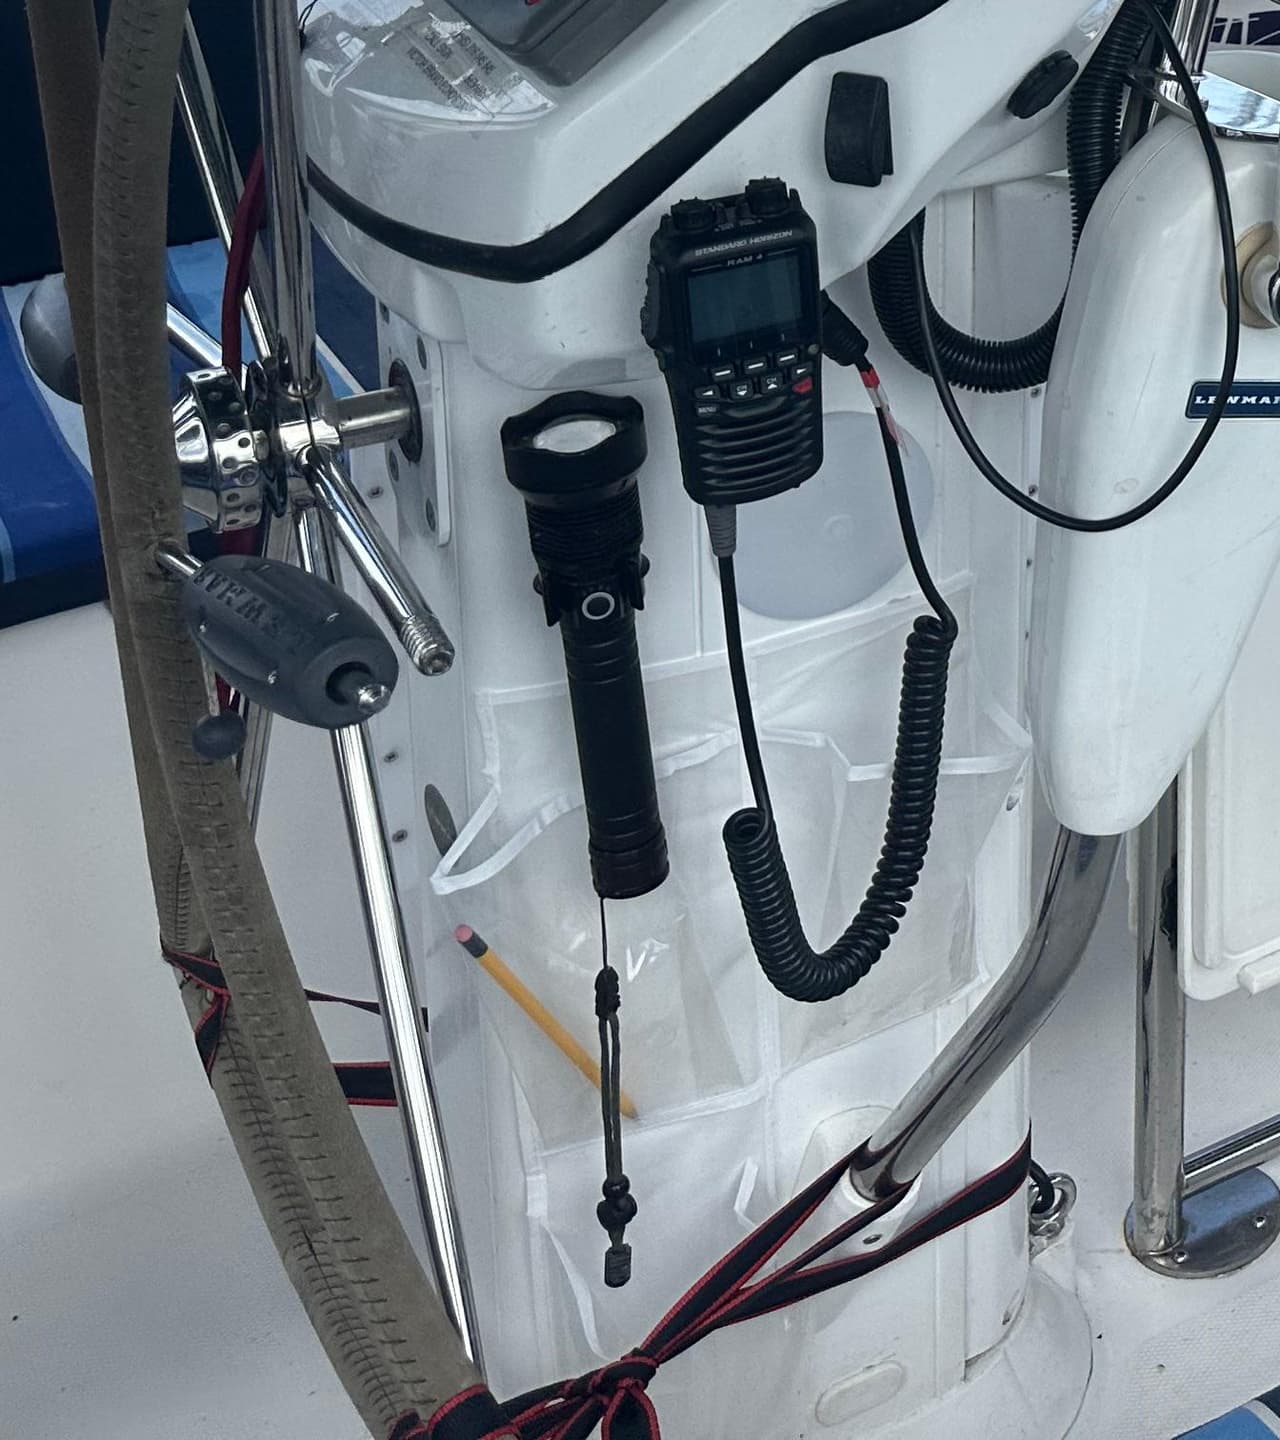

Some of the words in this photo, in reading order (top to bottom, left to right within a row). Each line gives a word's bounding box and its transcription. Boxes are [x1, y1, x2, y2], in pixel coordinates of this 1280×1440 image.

[695, 240, 748, 257] STANDARD
[749, 229, 793, 245] HORIZON
[728, 255, 753, 267] RAM
